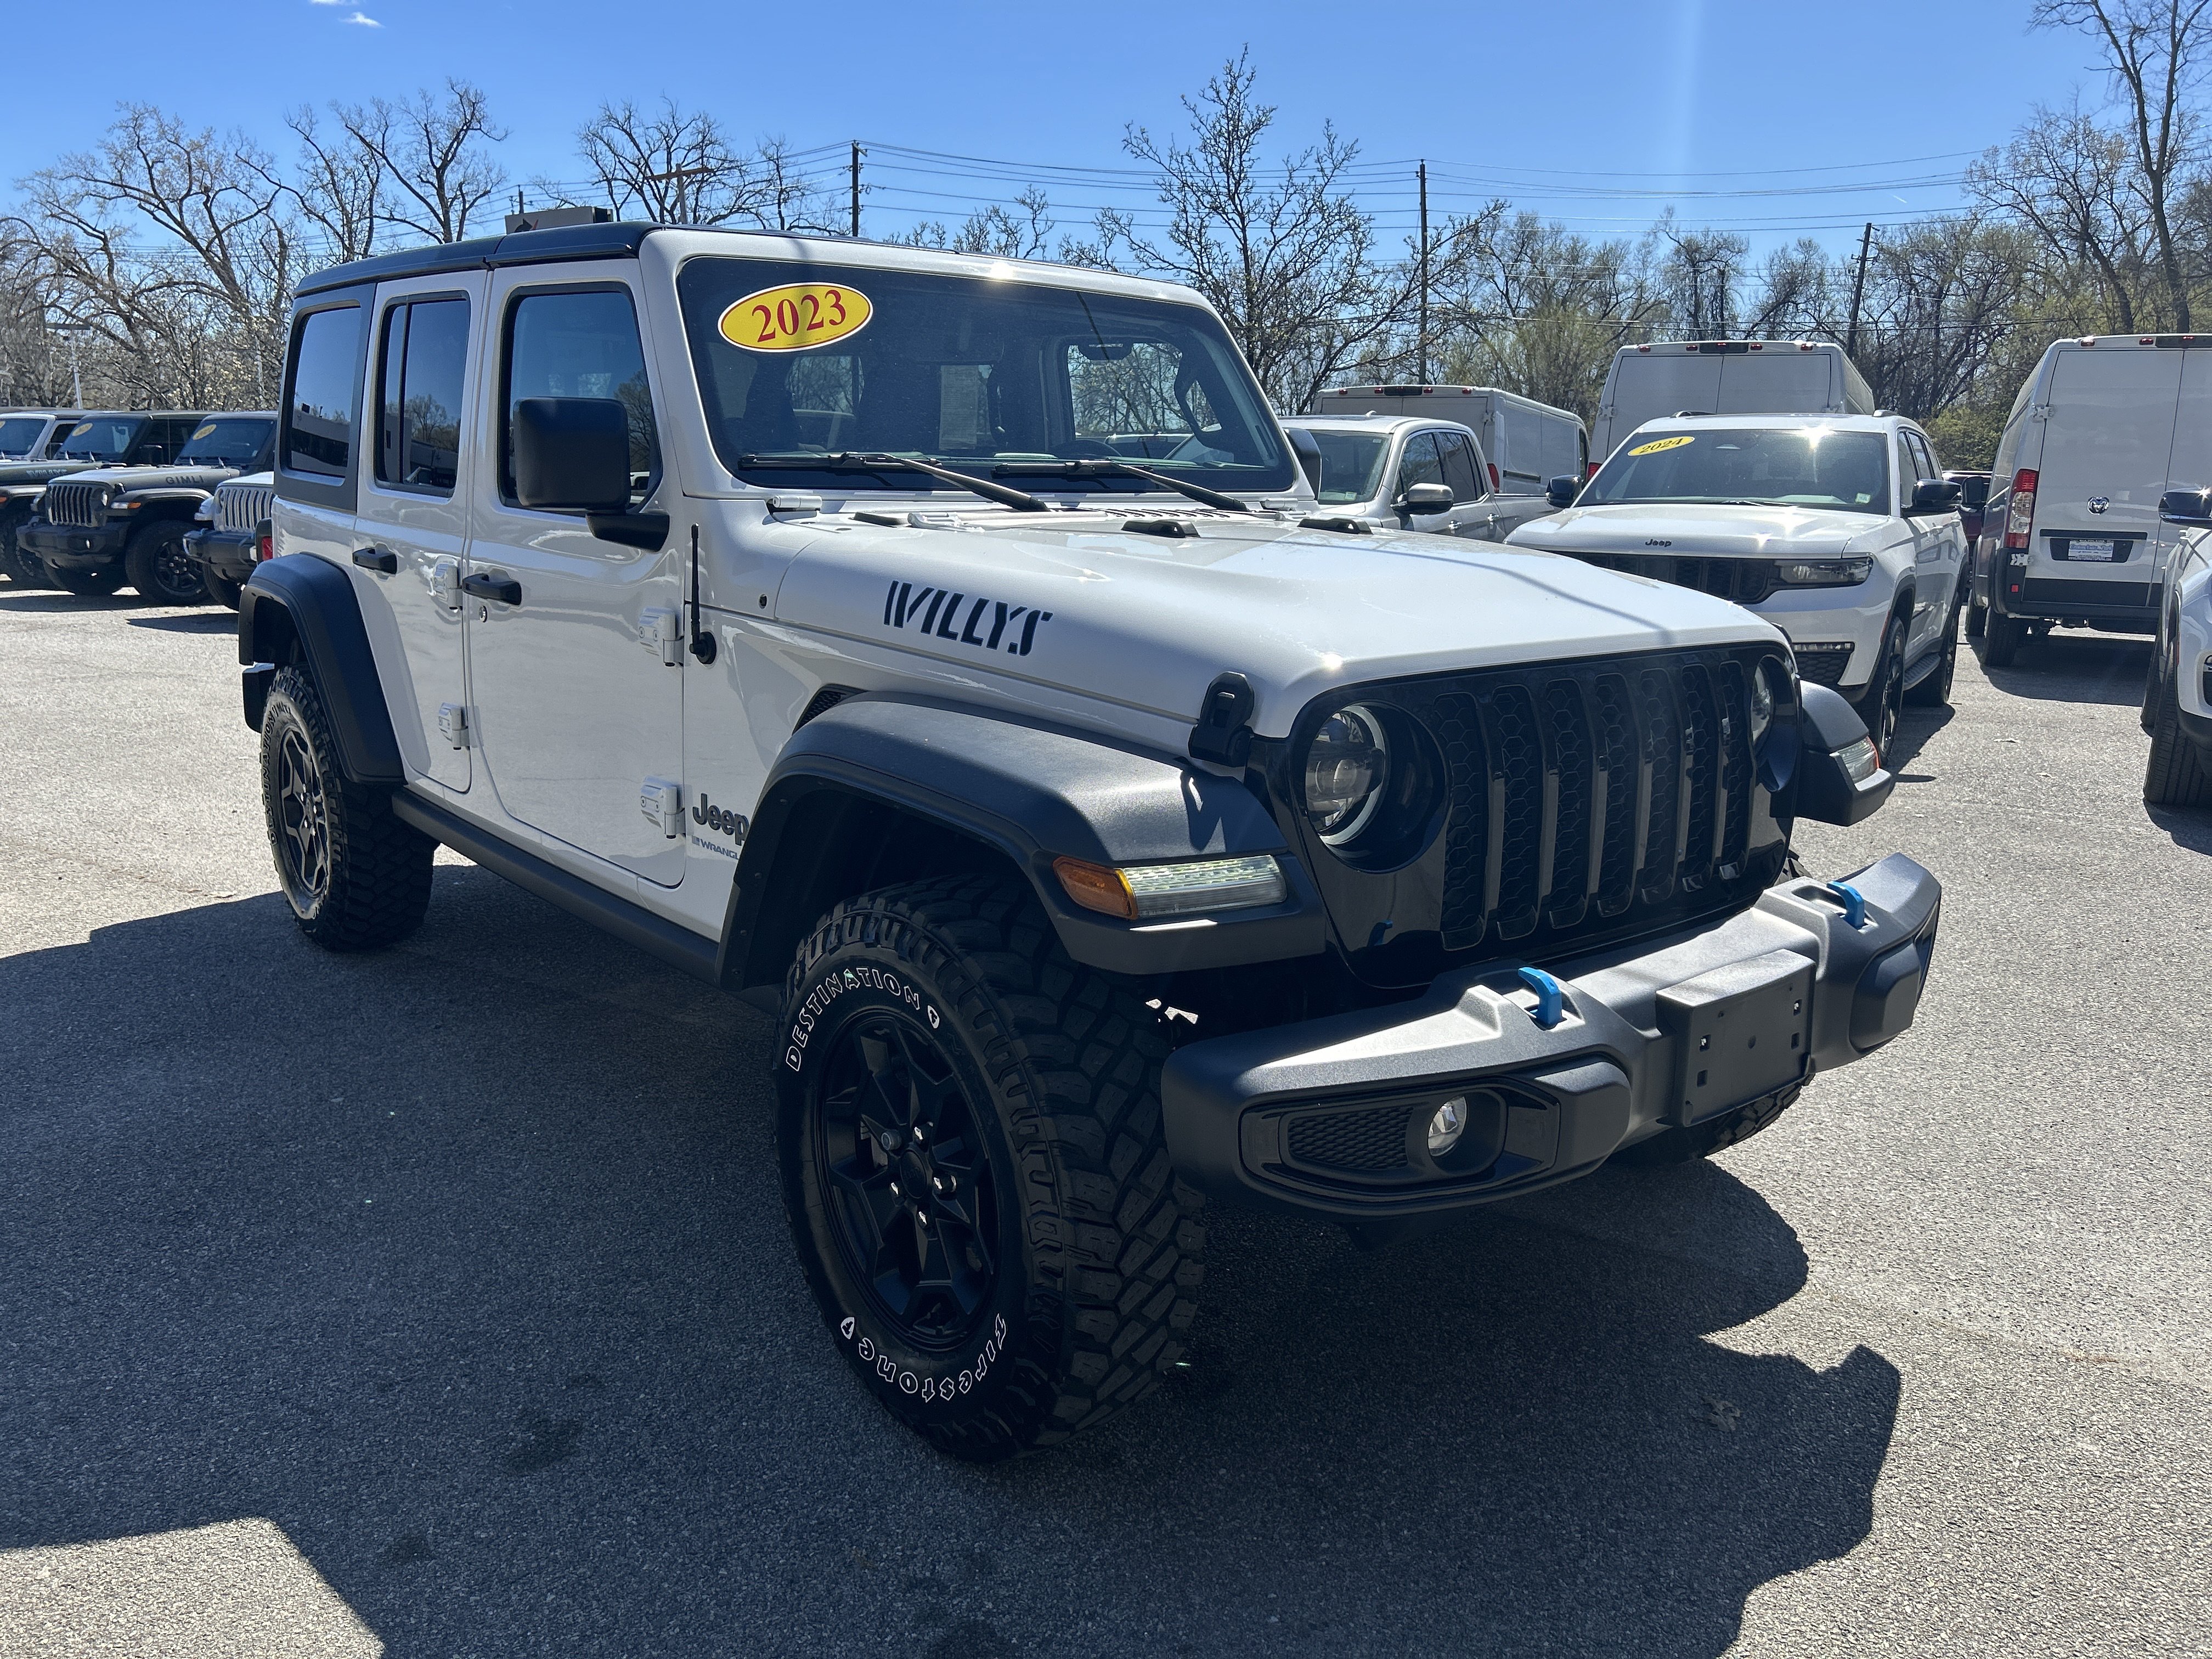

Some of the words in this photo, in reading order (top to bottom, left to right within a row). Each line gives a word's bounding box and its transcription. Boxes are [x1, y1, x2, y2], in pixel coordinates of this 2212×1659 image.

[751, 289, 847, 343] 2023
[1639, 438, 1684, 454] 2024
[1645, 538, 1672, 548] Jeep
[883, 580, 1053, 657] WILLYS
[692, 792, 750, 847] Jeep
[701, 838, 740, 860] WRANGL
[785, 967, 921, 1071] DESTINATION
[858, 1312, 1007, 1403] Firestone
